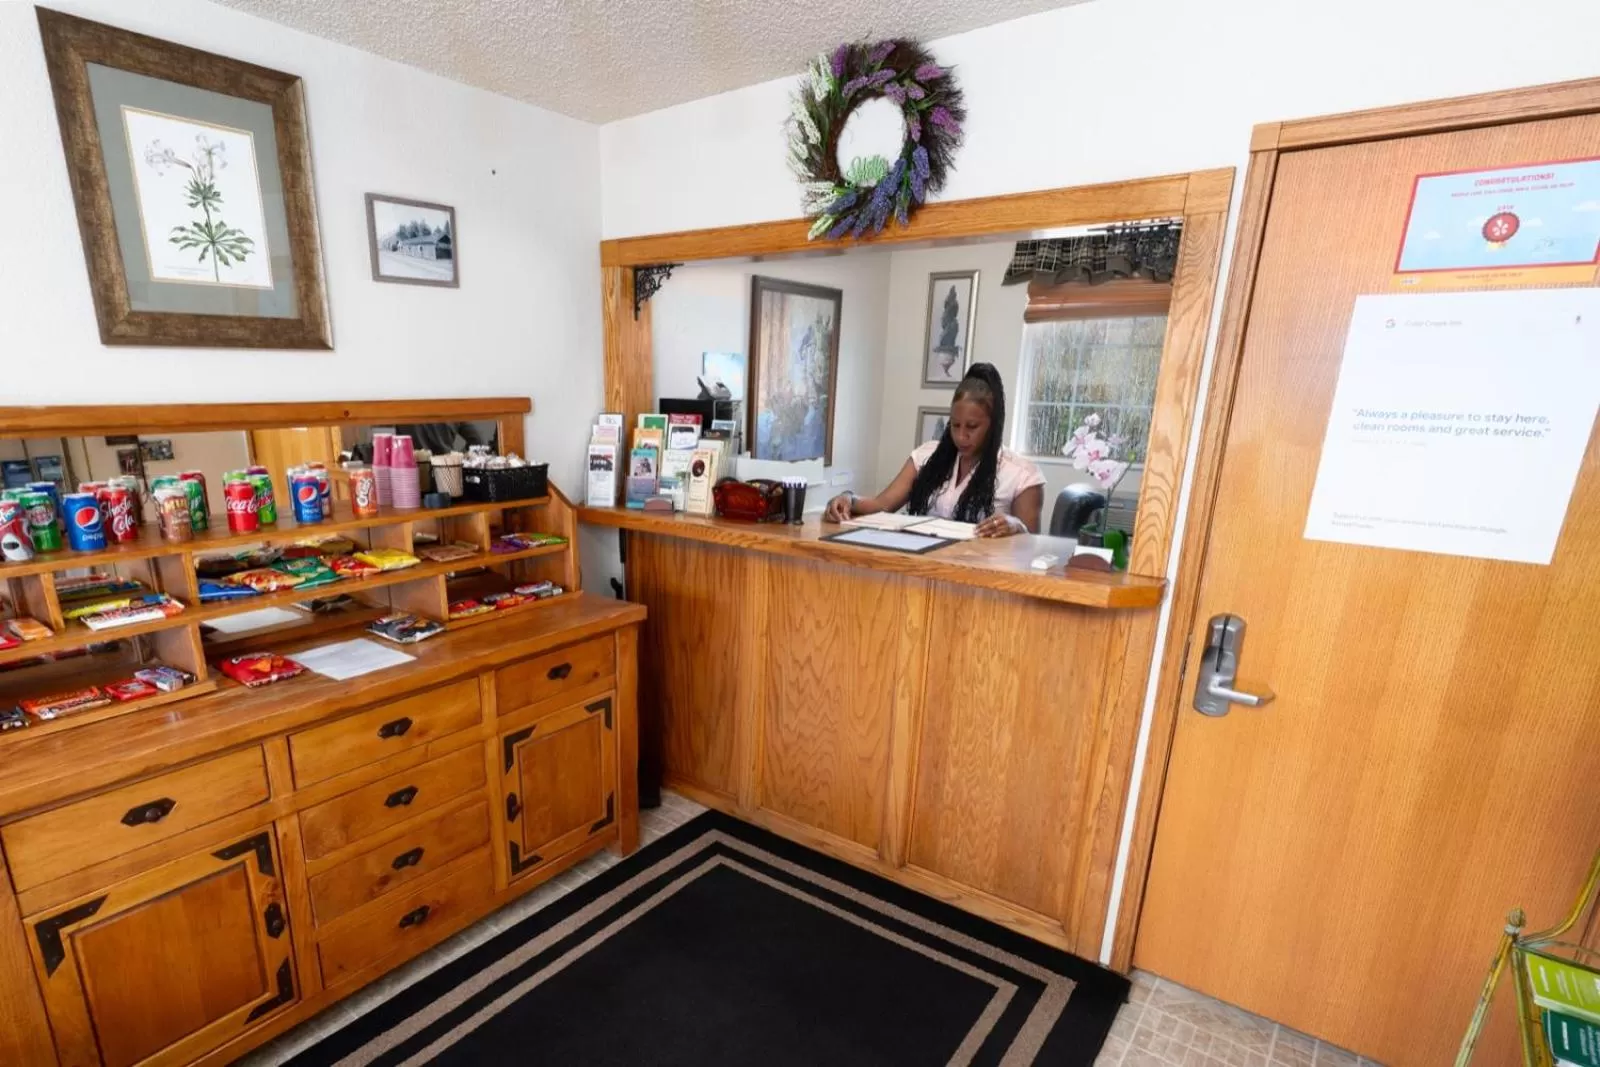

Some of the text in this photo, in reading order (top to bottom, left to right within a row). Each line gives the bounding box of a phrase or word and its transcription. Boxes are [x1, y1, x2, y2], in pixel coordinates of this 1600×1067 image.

[1410, 410, 1464, 421] pleasure
[1467, 413, 1481, 422] to
[1485, 413, 1512, 424] stay
[1352, 422, 1384, 431] clean
[1387, 423, 1425, 432] rooms
[1428, 424, 1453, 434] and
[1455, 426, 1489, 436] great
